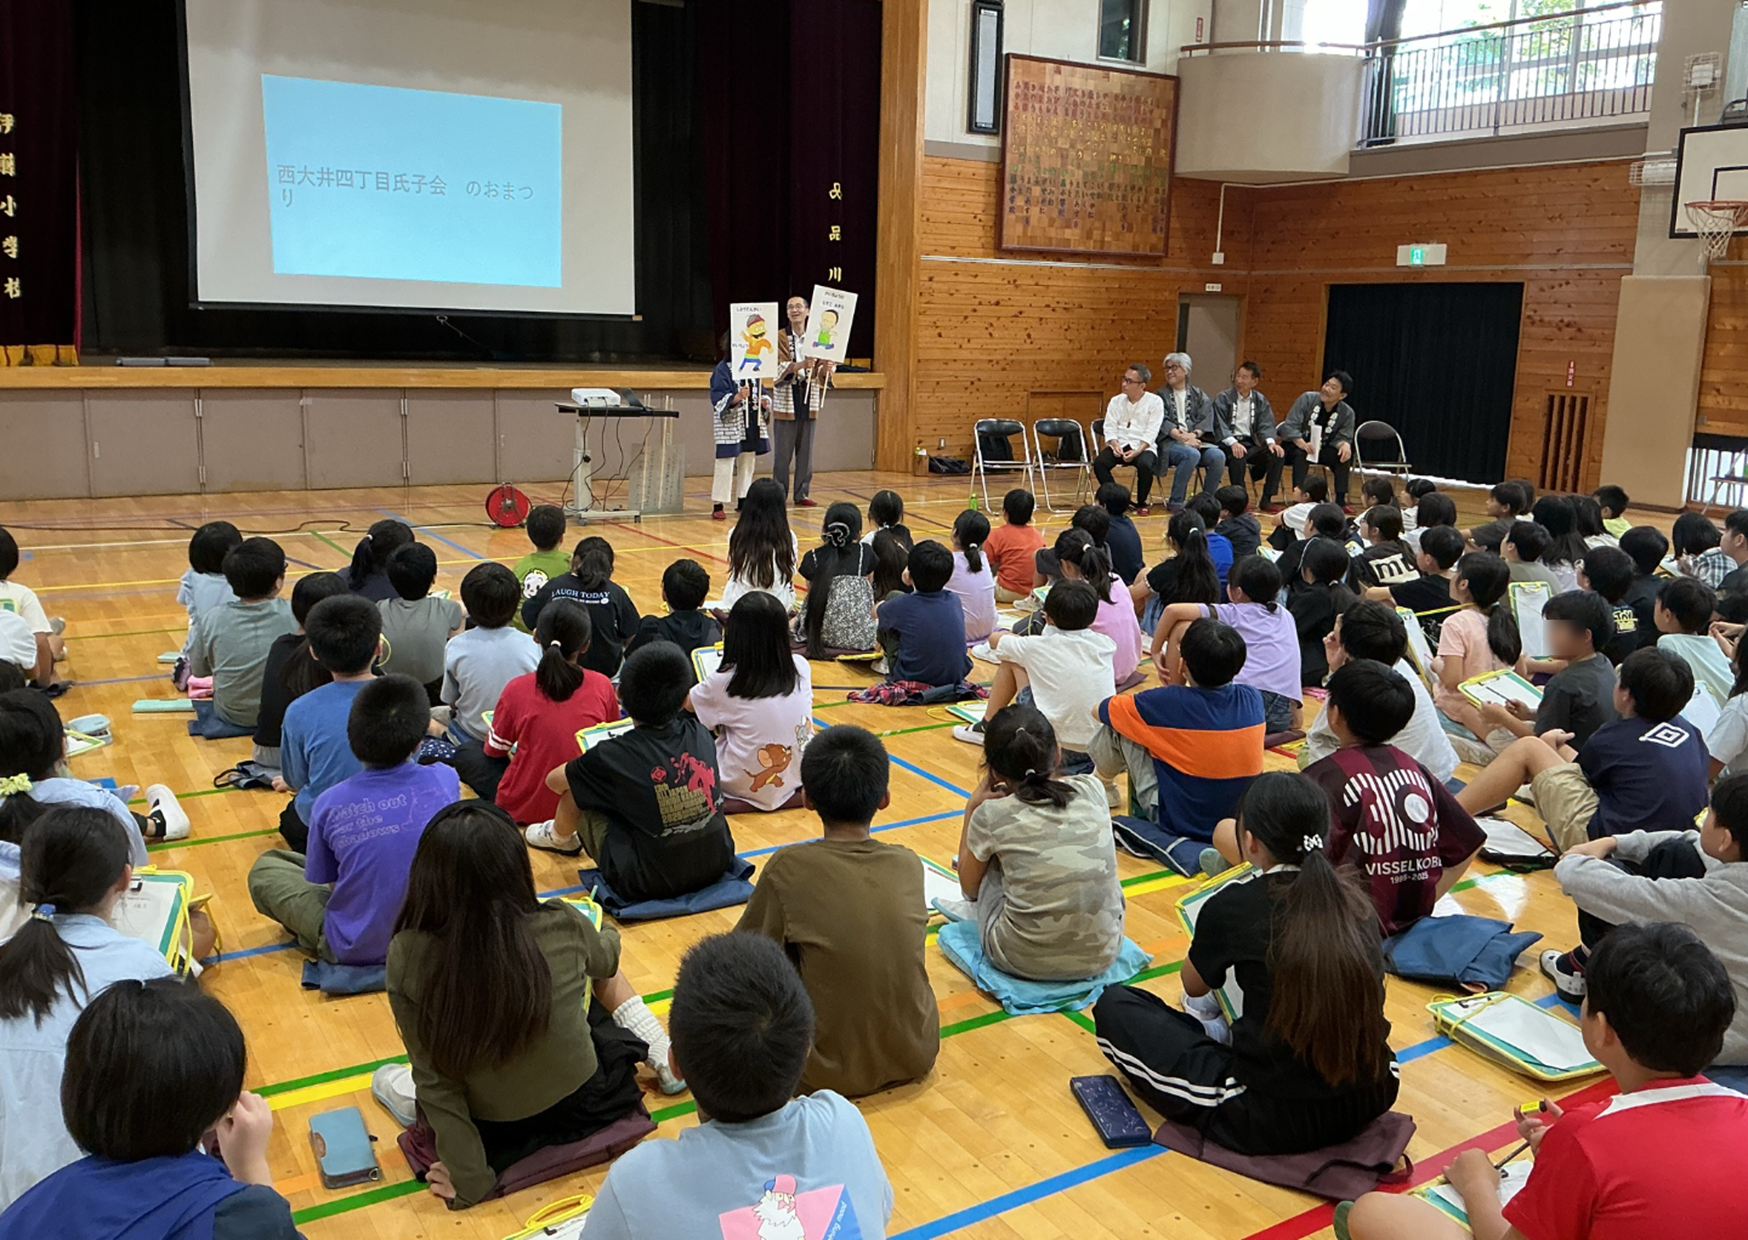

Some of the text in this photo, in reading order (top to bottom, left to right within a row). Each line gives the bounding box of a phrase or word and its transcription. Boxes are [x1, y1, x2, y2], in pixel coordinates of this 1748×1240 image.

[277, 164, 534, 201] 西大井四丁目氏子会 のおまつ
[282, 188, 294, 208] り
[551, 588, 610, 599] LAUGH TODAY
[378, 793, 408, 811] out
[356, 815, 383, 828] the
[1365, 859, 1415, 876] VISSEL
[836, 1200, 848, 1222] mood
